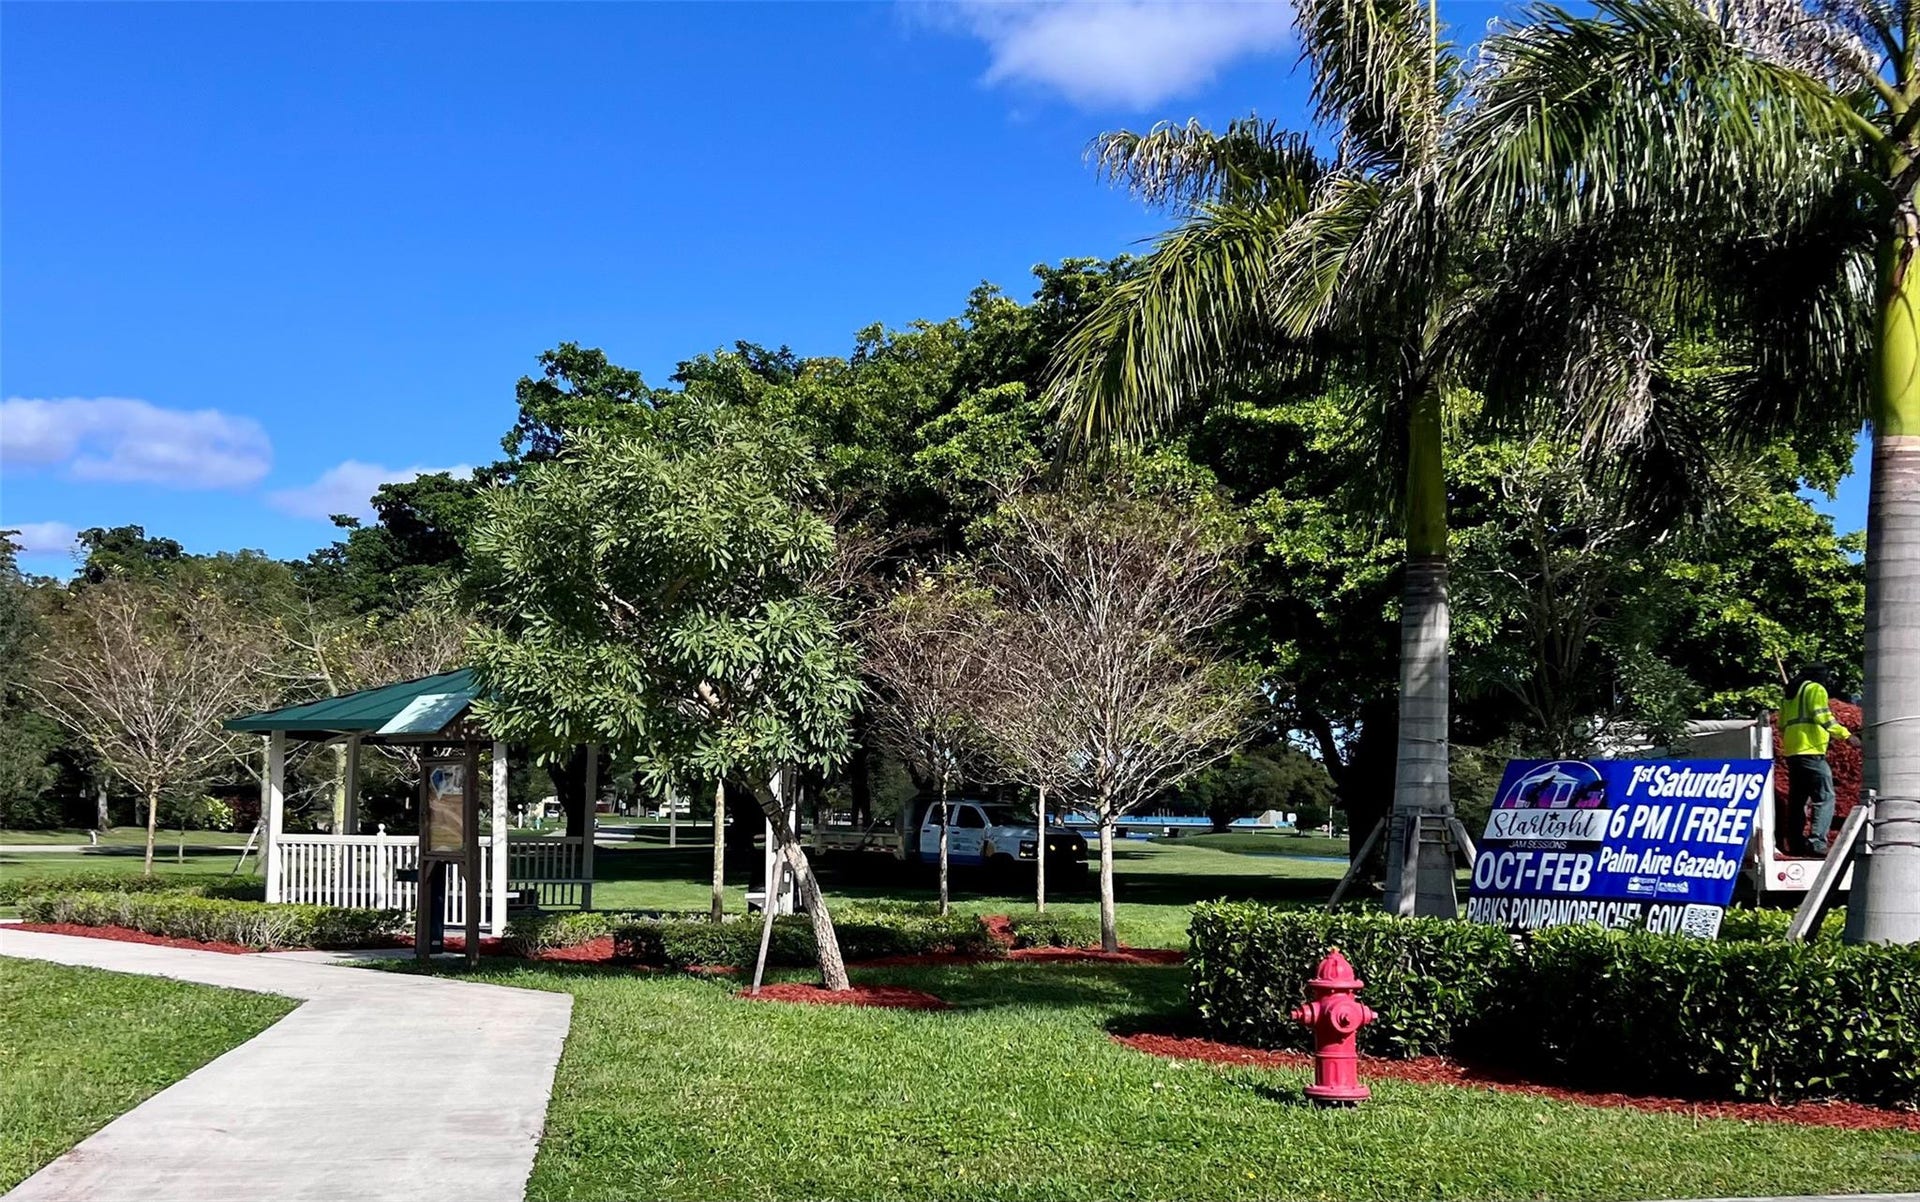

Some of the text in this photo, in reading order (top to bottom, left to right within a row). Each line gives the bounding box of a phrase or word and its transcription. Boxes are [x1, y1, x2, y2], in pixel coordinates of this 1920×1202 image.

[1626, 764, 1764, 808] 1st Saturdays
[1494, 809, 1596, 839] Starlight
[1609, 804, 1629, 839] 6
[1627, 805, 1673, 840] PM
[1682, 807, 1753, 844] FREE
[1508, 840, 1567, 850] JAM SESSIONS
[1597, 846, 1737, 880] Palm Aire Gazebo
[1475, 851, 1594, 892] OCT-FEB
